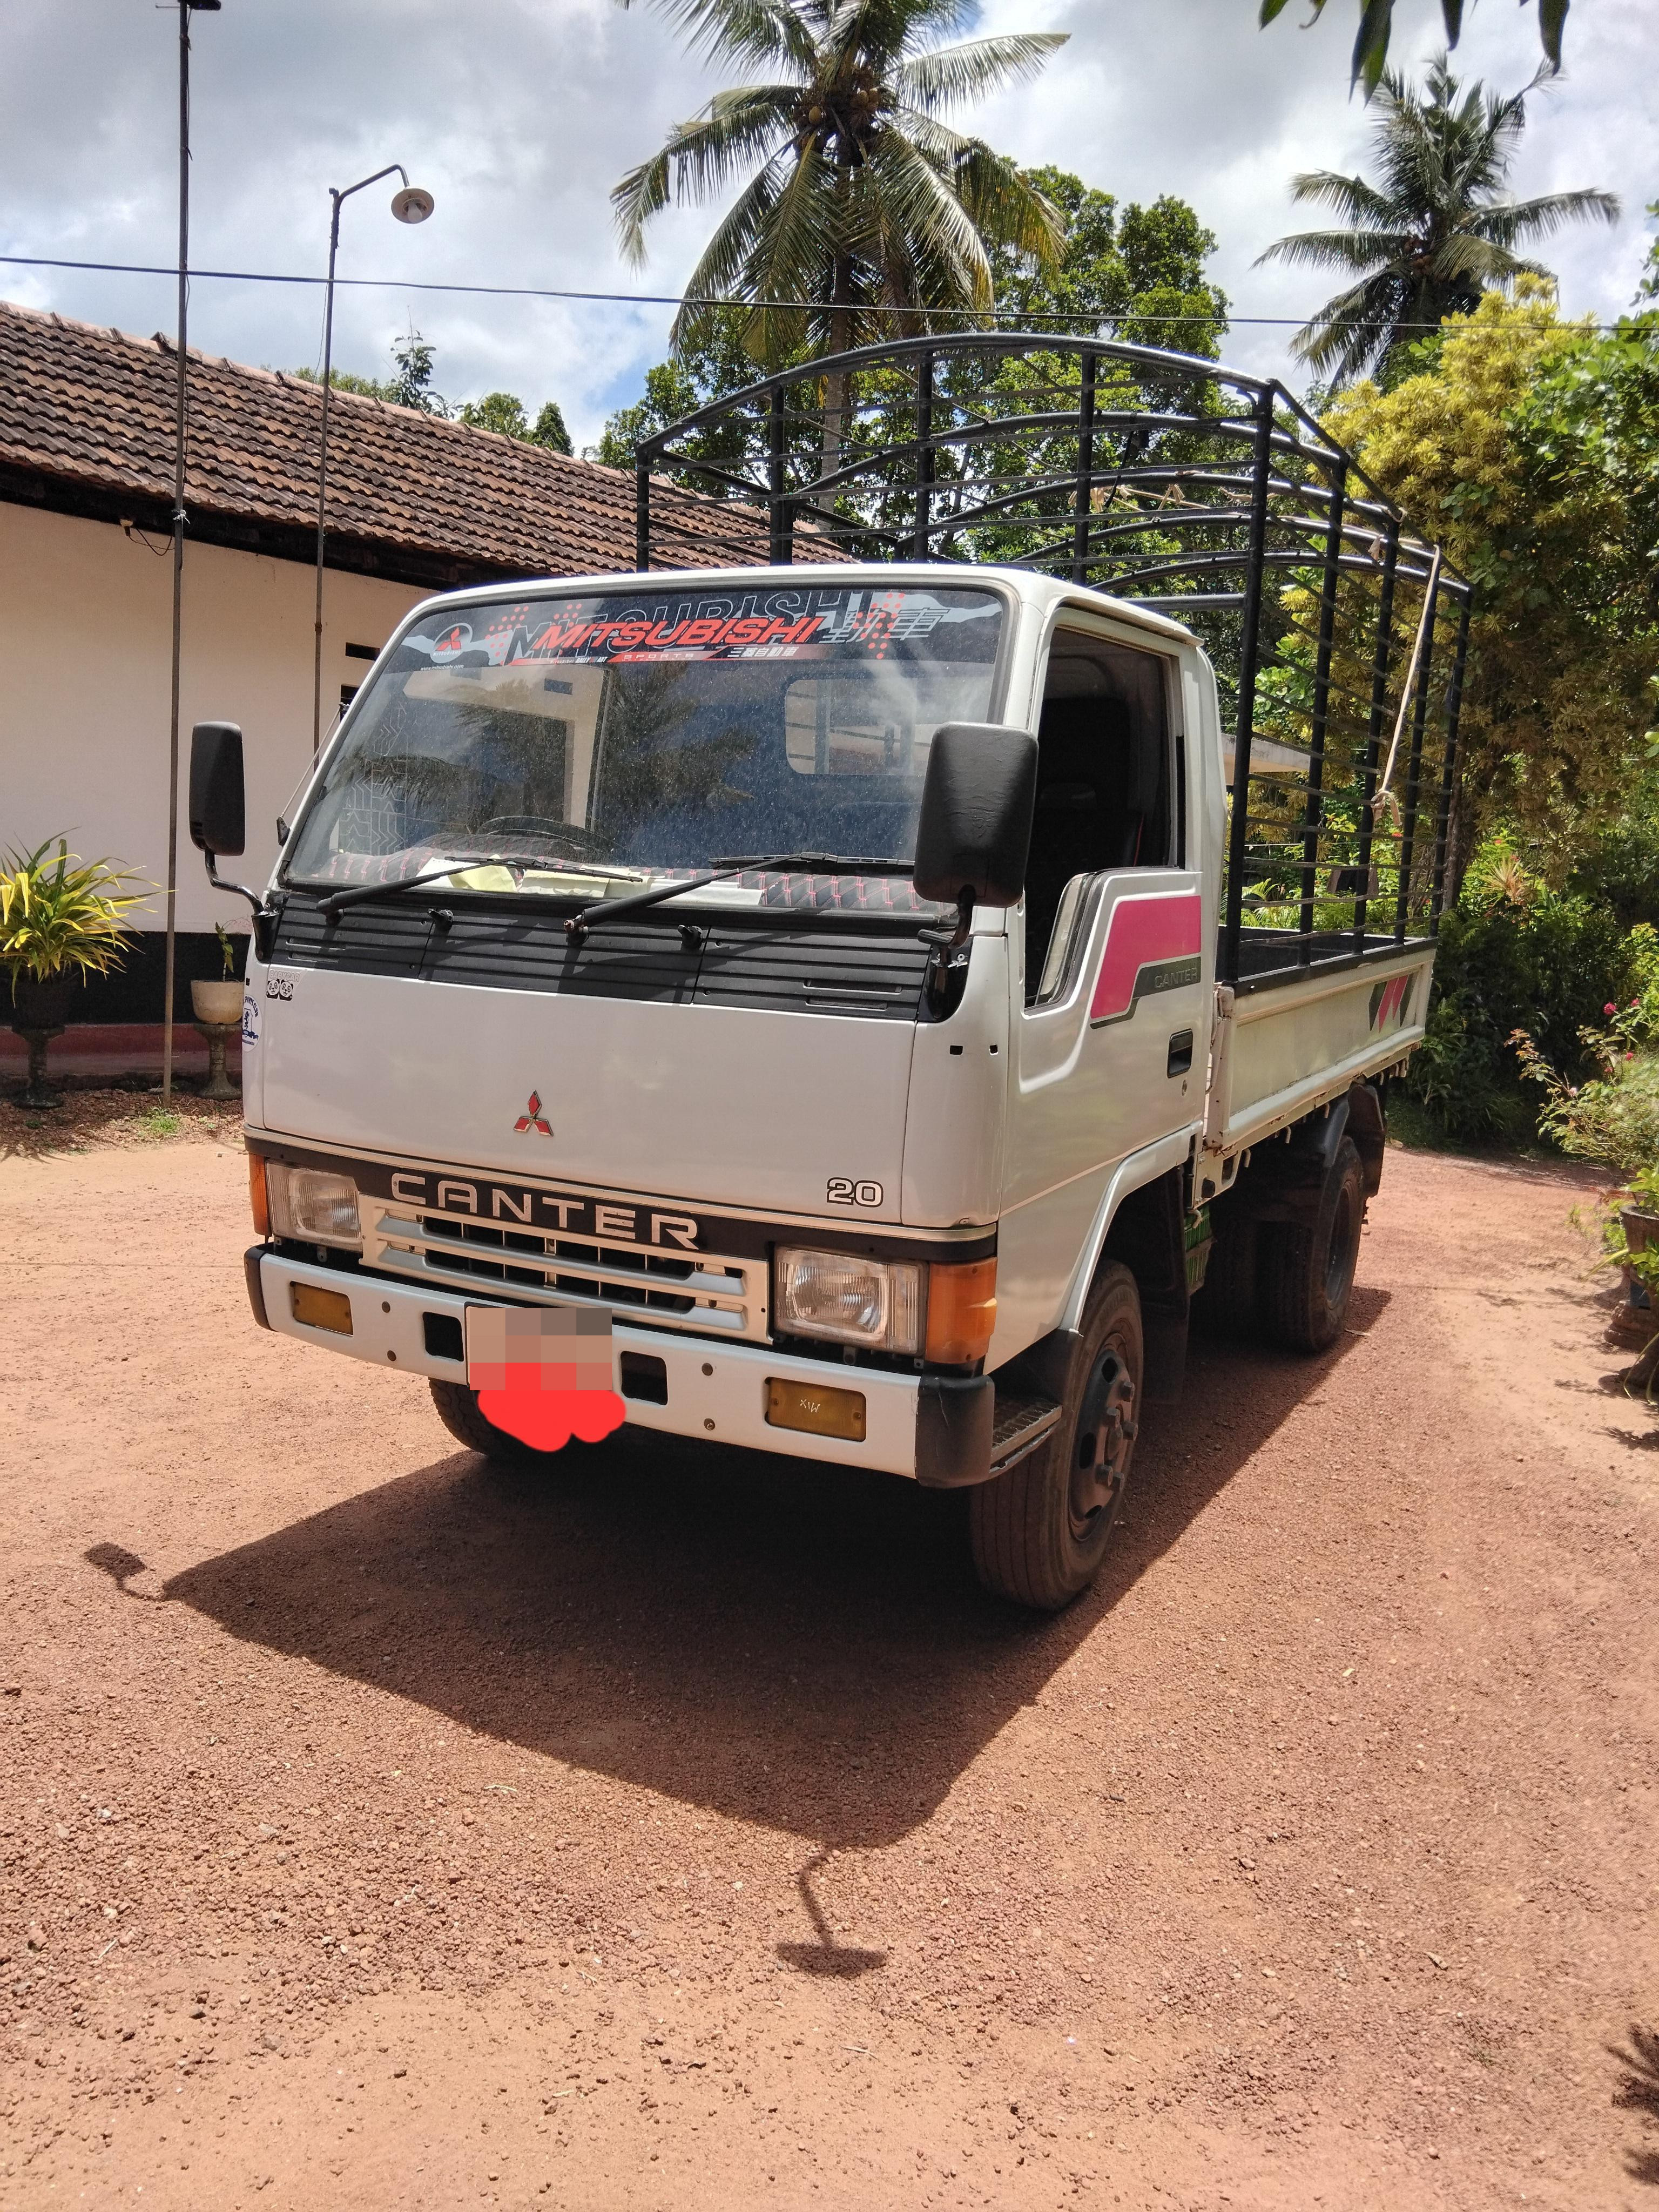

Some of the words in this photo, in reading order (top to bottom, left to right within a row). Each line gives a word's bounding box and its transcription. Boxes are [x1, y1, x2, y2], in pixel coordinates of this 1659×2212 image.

[532, 616, 826, 650] MITSUBISHI
[1155, 968, 1197, 988] CANTER
[827, 1177, 884, 1208] 20
[392, 1172, 699, 1250] CANTER
